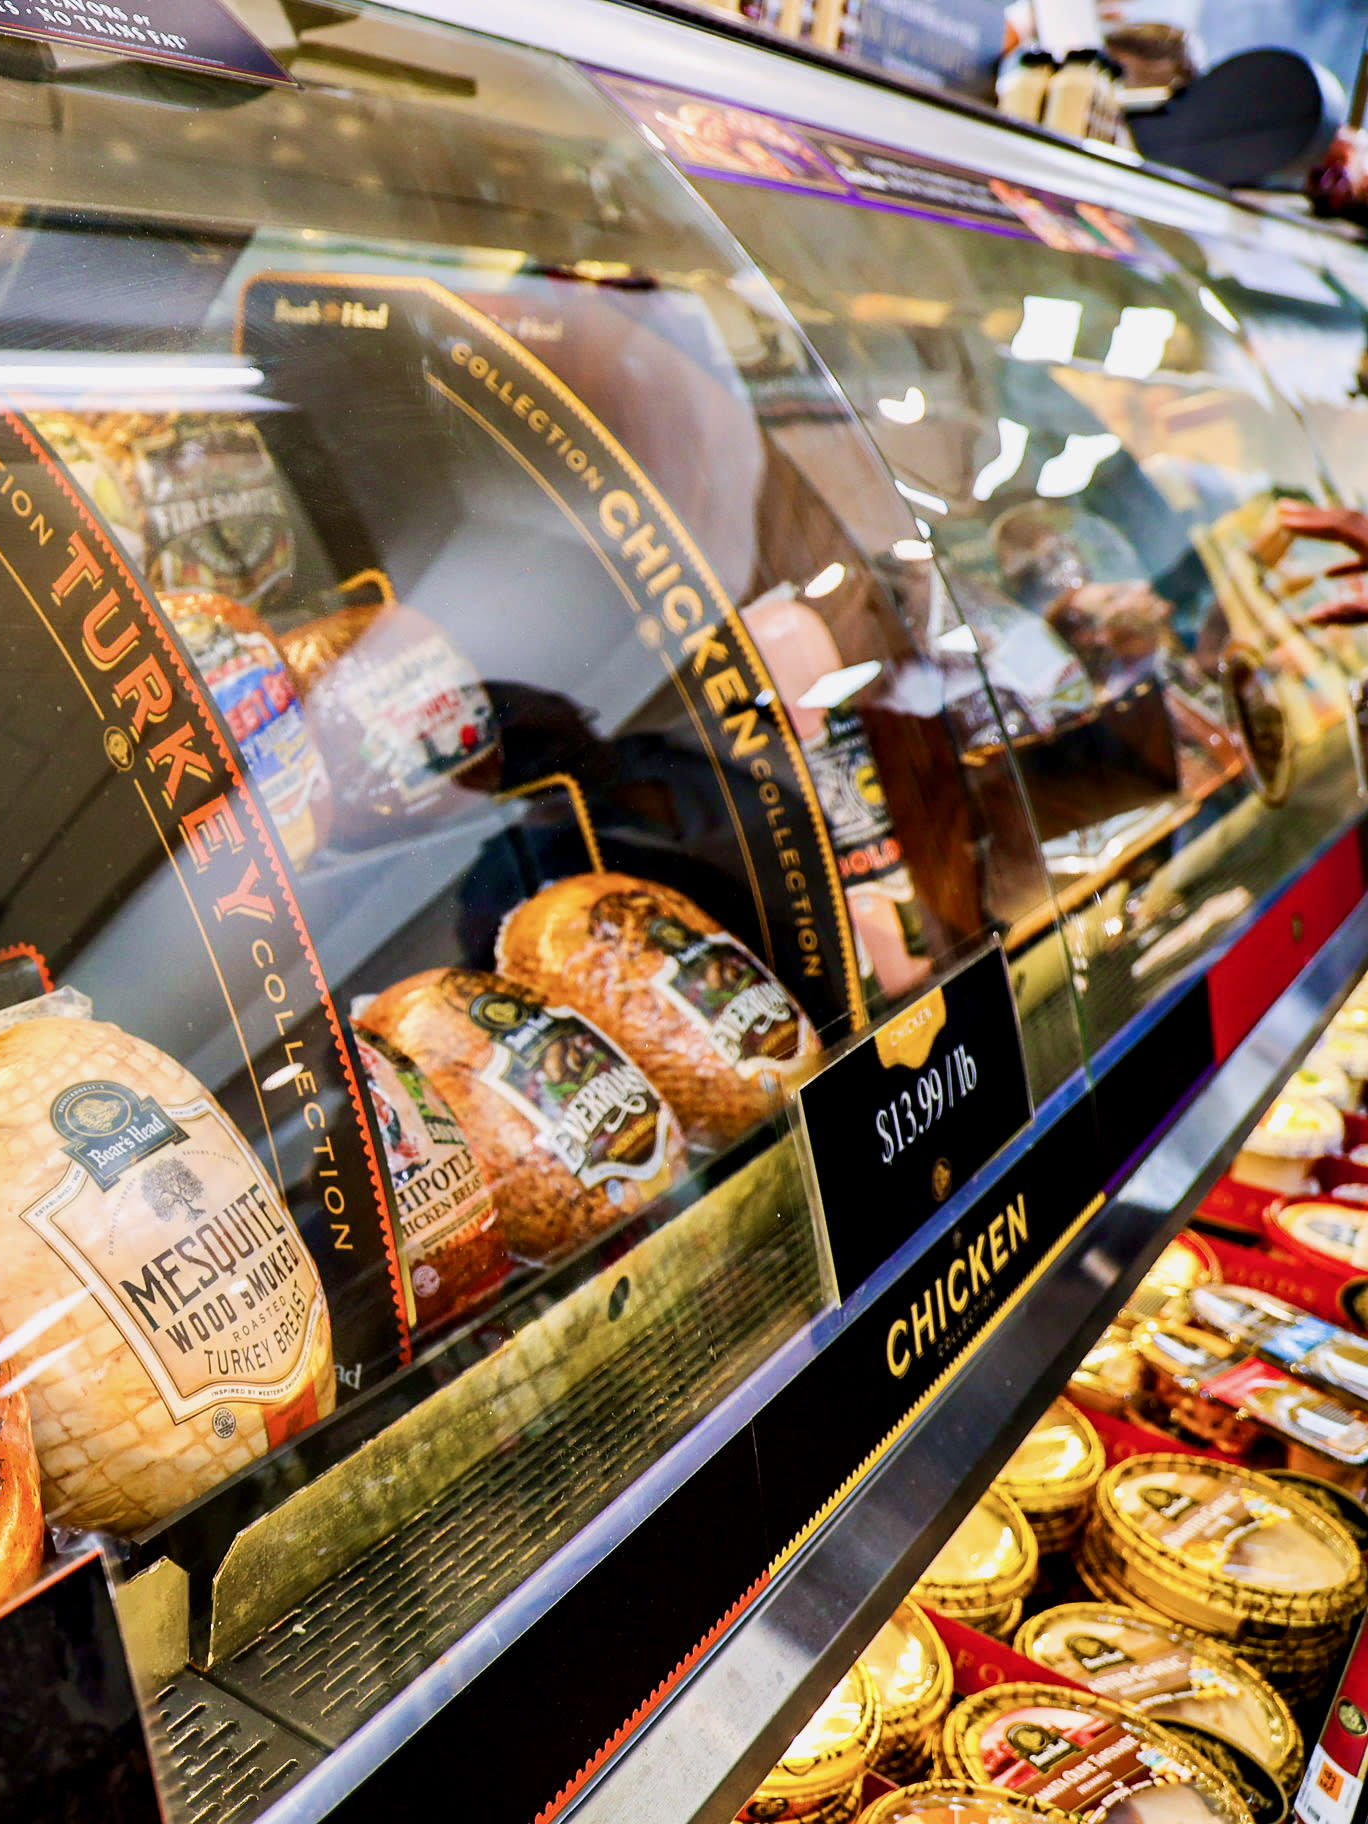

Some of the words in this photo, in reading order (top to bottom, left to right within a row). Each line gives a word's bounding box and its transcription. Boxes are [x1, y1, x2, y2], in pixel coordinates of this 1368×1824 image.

[35, 6, 72, 26] NO
[73, 14, 147, 42] TRANS
[450, 343, 606, 494] COLLECTION
[598, 488, 772, 761] CHICKEN
[51, 531, 277, 924] TURKEY
[750, 757, 826, 979] COLLECTION
[251, 938, 354, 1250] COLLECTION
[888, 1007, 933, 1048] CHICKEN
[87, 1137, 135, 1170] Boar's
[125, 1113, 167, 1145] Head
[119, 1183, 286, 1333] MESQUITE
[165, 1292, 239, 1355] WOOD
[239, 1238, 299, 1311] SMOKED
[231, 1295, 287, 1343] ROASTED
[886, 1192, 1030, 1379] CHICKEN
[203, 1337, 276, 1376] TURKEY
[273, 1279, 308, 1355] BREAST
[210, 1388, 245, 1397] INSPIRED
